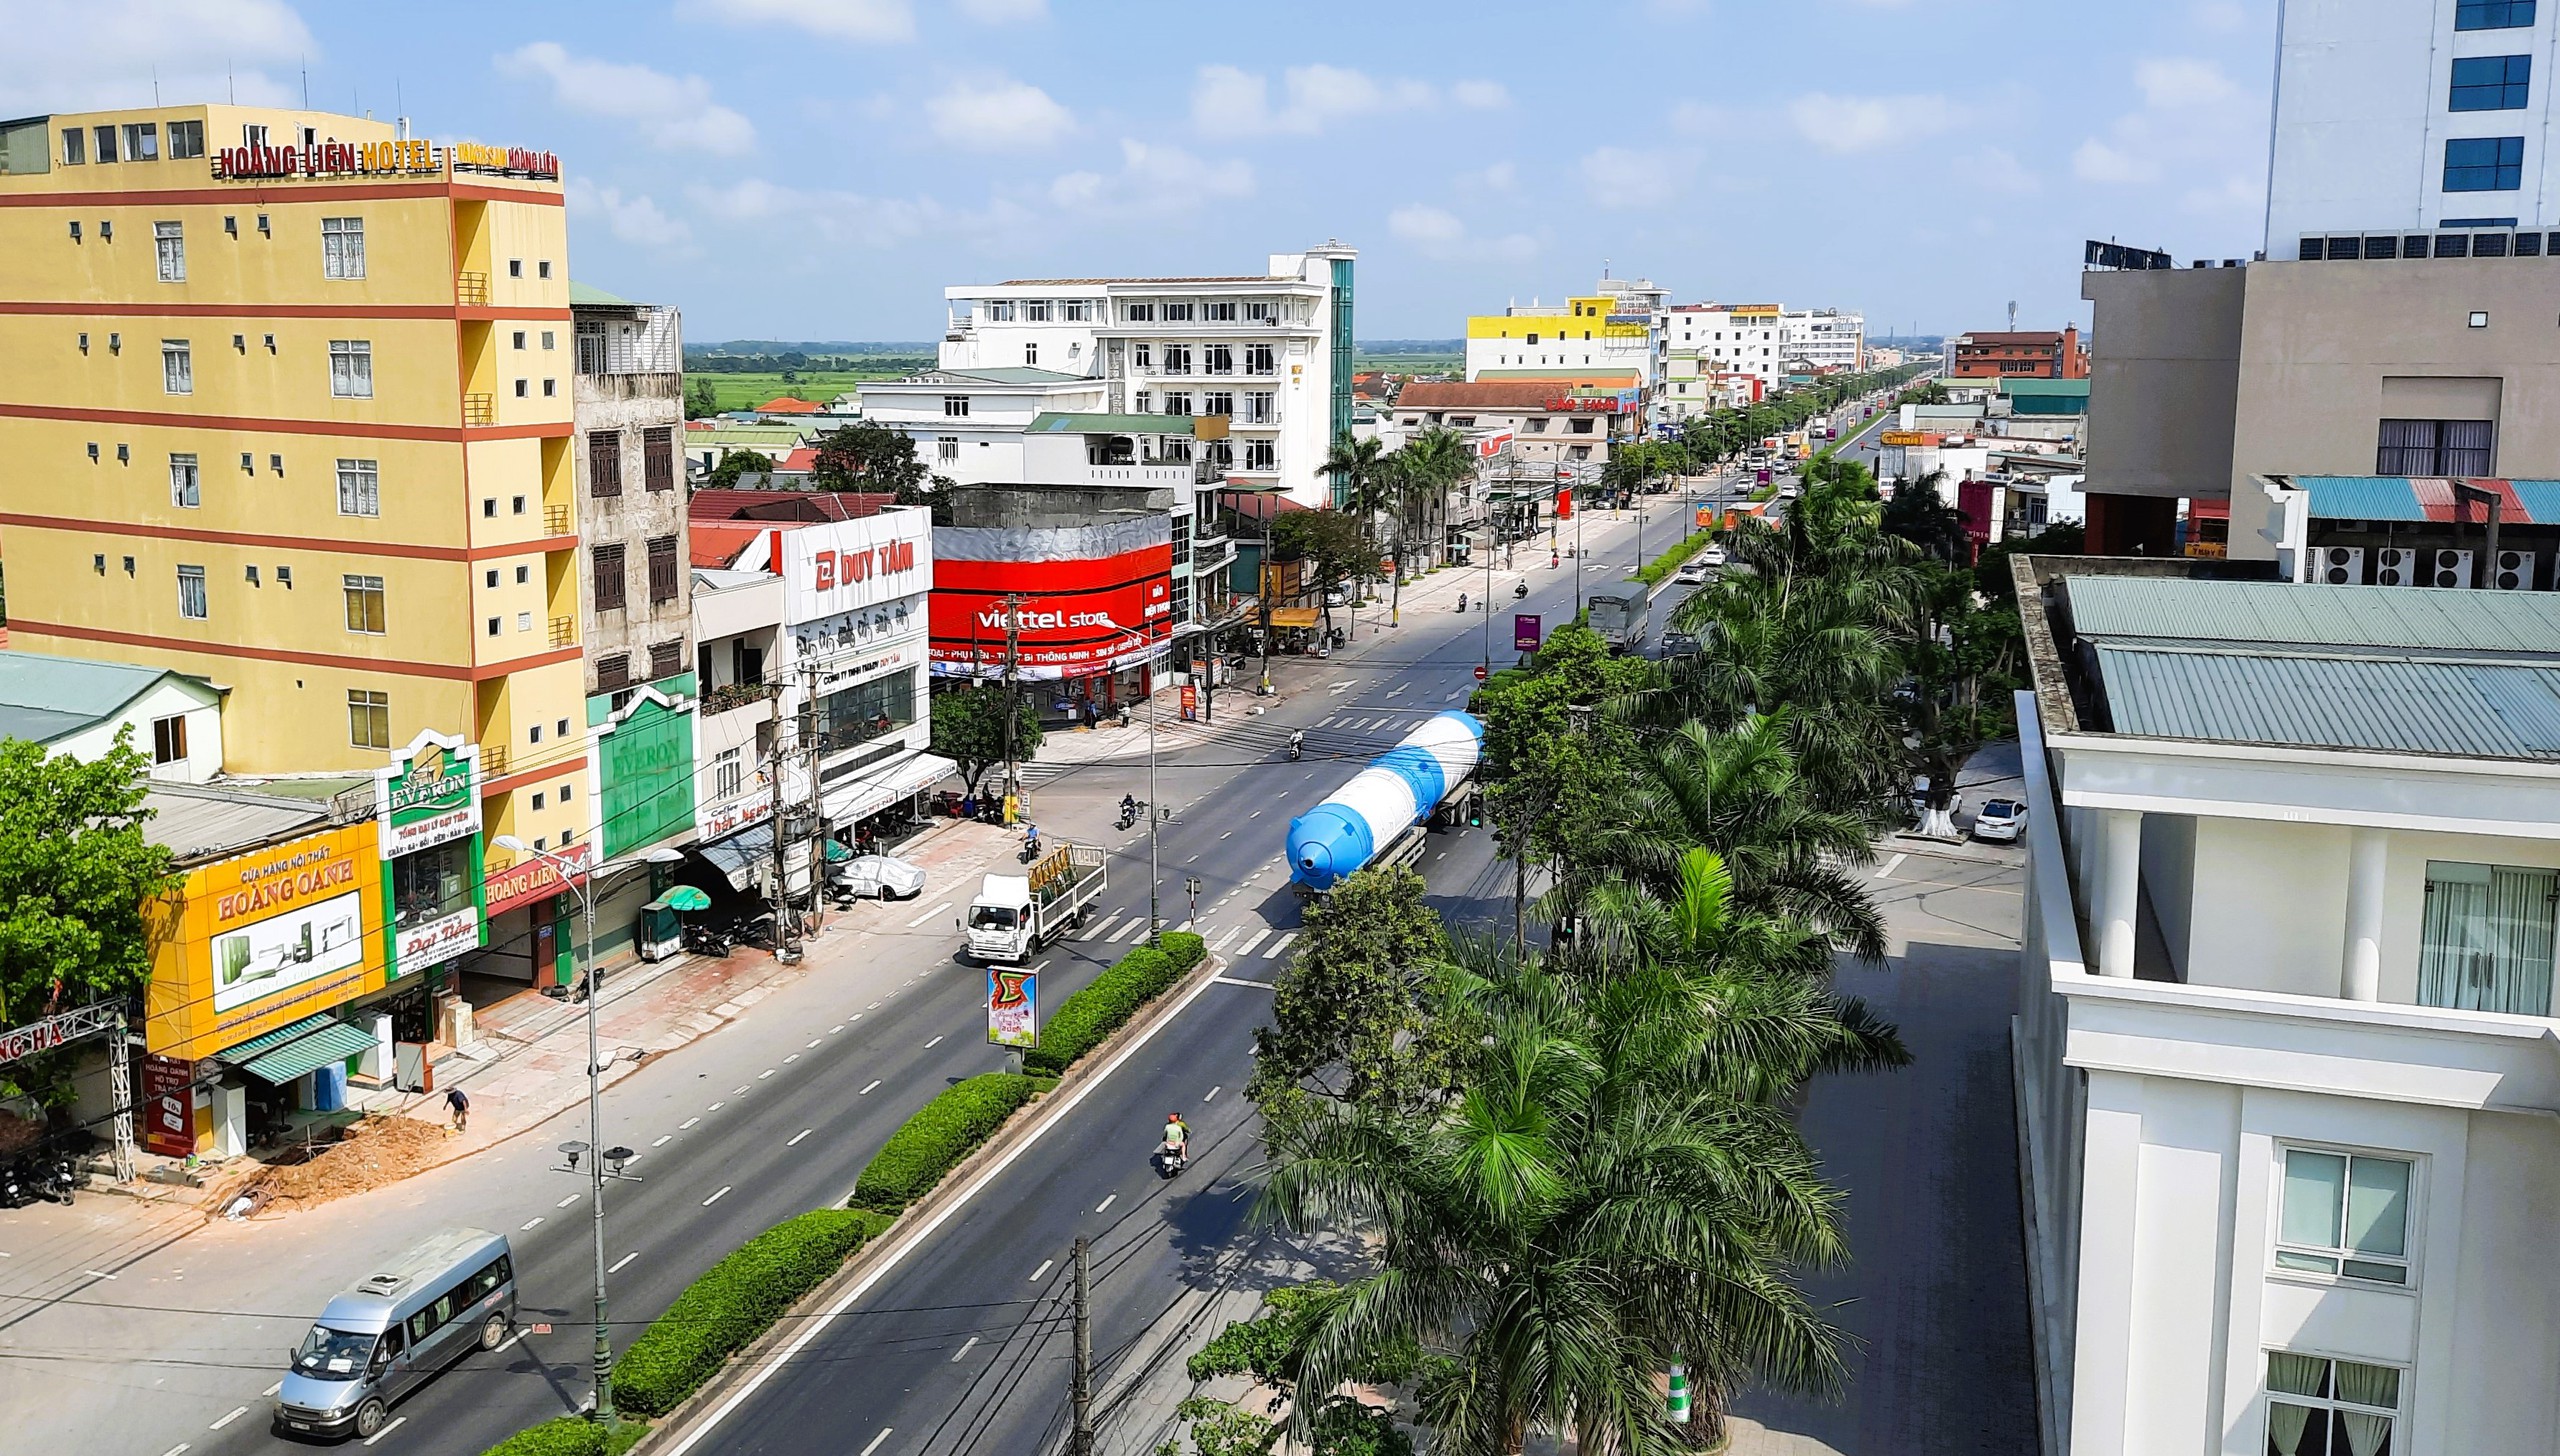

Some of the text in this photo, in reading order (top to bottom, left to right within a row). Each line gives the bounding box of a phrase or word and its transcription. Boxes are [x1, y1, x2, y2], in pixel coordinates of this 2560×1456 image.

[220, 137, 437, 176] HOÀNG LIÊN HOTEL
[841, 538, 914, 586] DUY TÂM
[978, 610, 1109, 629] viettel store
[951, 650, 968, 660] PHỤ
[1036, 649, 1068, 661] THÔNG
[1069, 651, 1090, 660] MINH
[241, 845, 331, 884] CỬA HÀNG NỘI THẤT
[218, 859, 354, 921] HOÀNG OANH
[486, 874, 528, 905] HOÀNG
